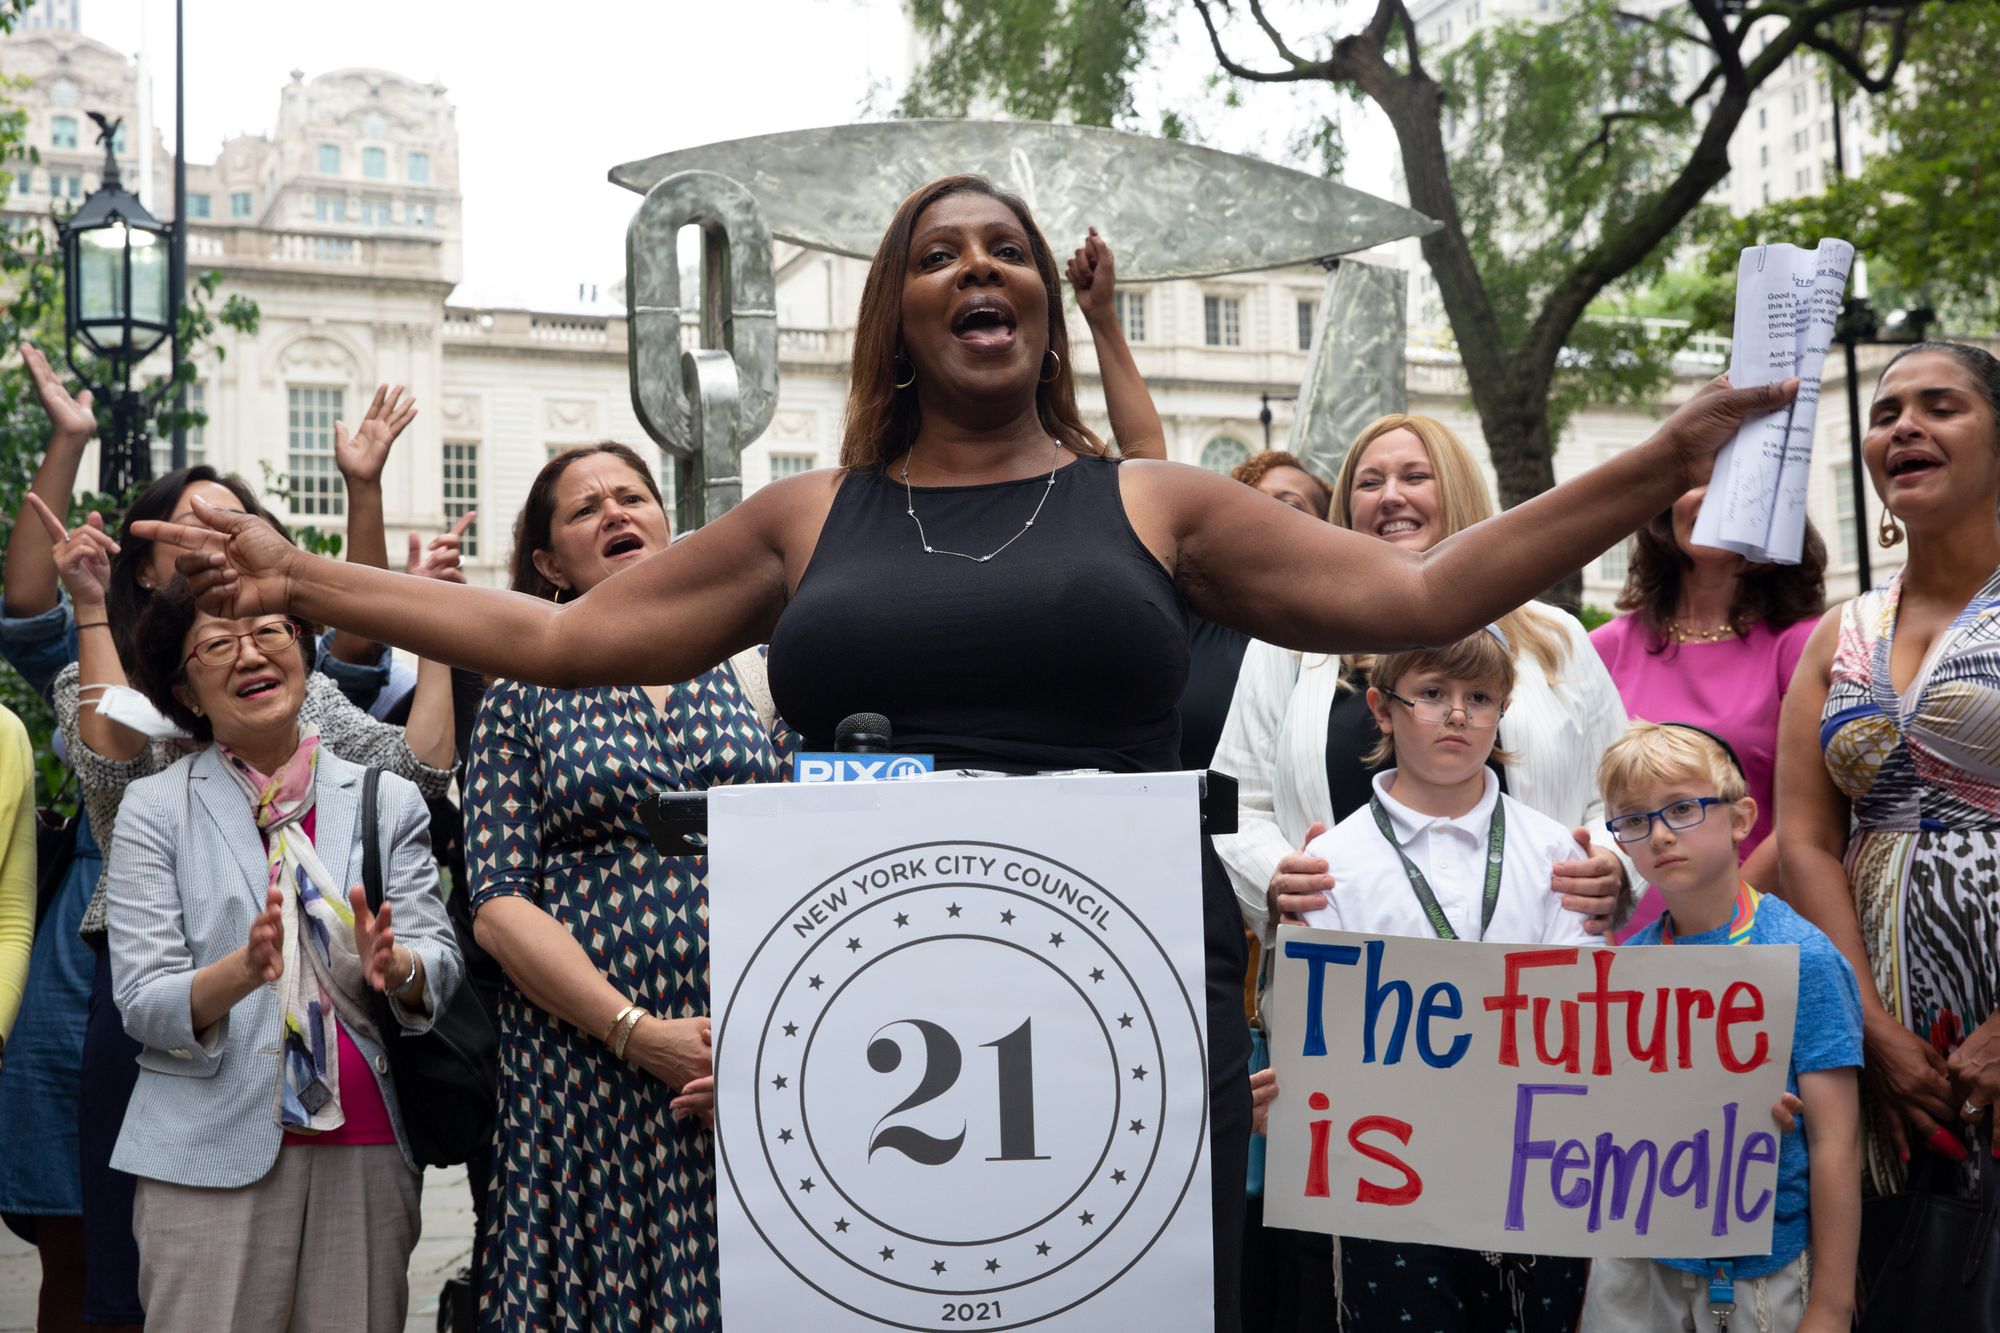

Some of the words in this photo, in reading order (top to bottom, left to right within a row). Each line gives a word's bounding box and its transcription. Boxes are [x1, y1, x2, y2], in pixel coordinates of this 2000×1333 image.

[1768, 292, 1789, 300] Good
[1768, 312, 1788, 320] were
[1768, 321, 1796, 329] thirtee
[1768, 331, 1796, 339] Counc
[1770, 350, 1785, 358] And
[800, 760, 887, 783] PIX
[1490, 825, 1503, 852] SPECIES
[1485, 863, 1501, 901] UNKNOWN
[793, 887, 847, 938] NEW
[853, 859, 927, 894] YORK
[936, 856, 996, 875] CITY
[1004, 863, 1110, 931] COUNCIL
[1285, 940, 1472, 1069] The
[1483, 948, 1770, 1076] Future
[867, 1016, 1052, 1165] 21
[1305, 1092, 1423, 1206] is
[1505, 1084, 1776, 1236] Female
[941, 1301, 1002, 1321] 2021
